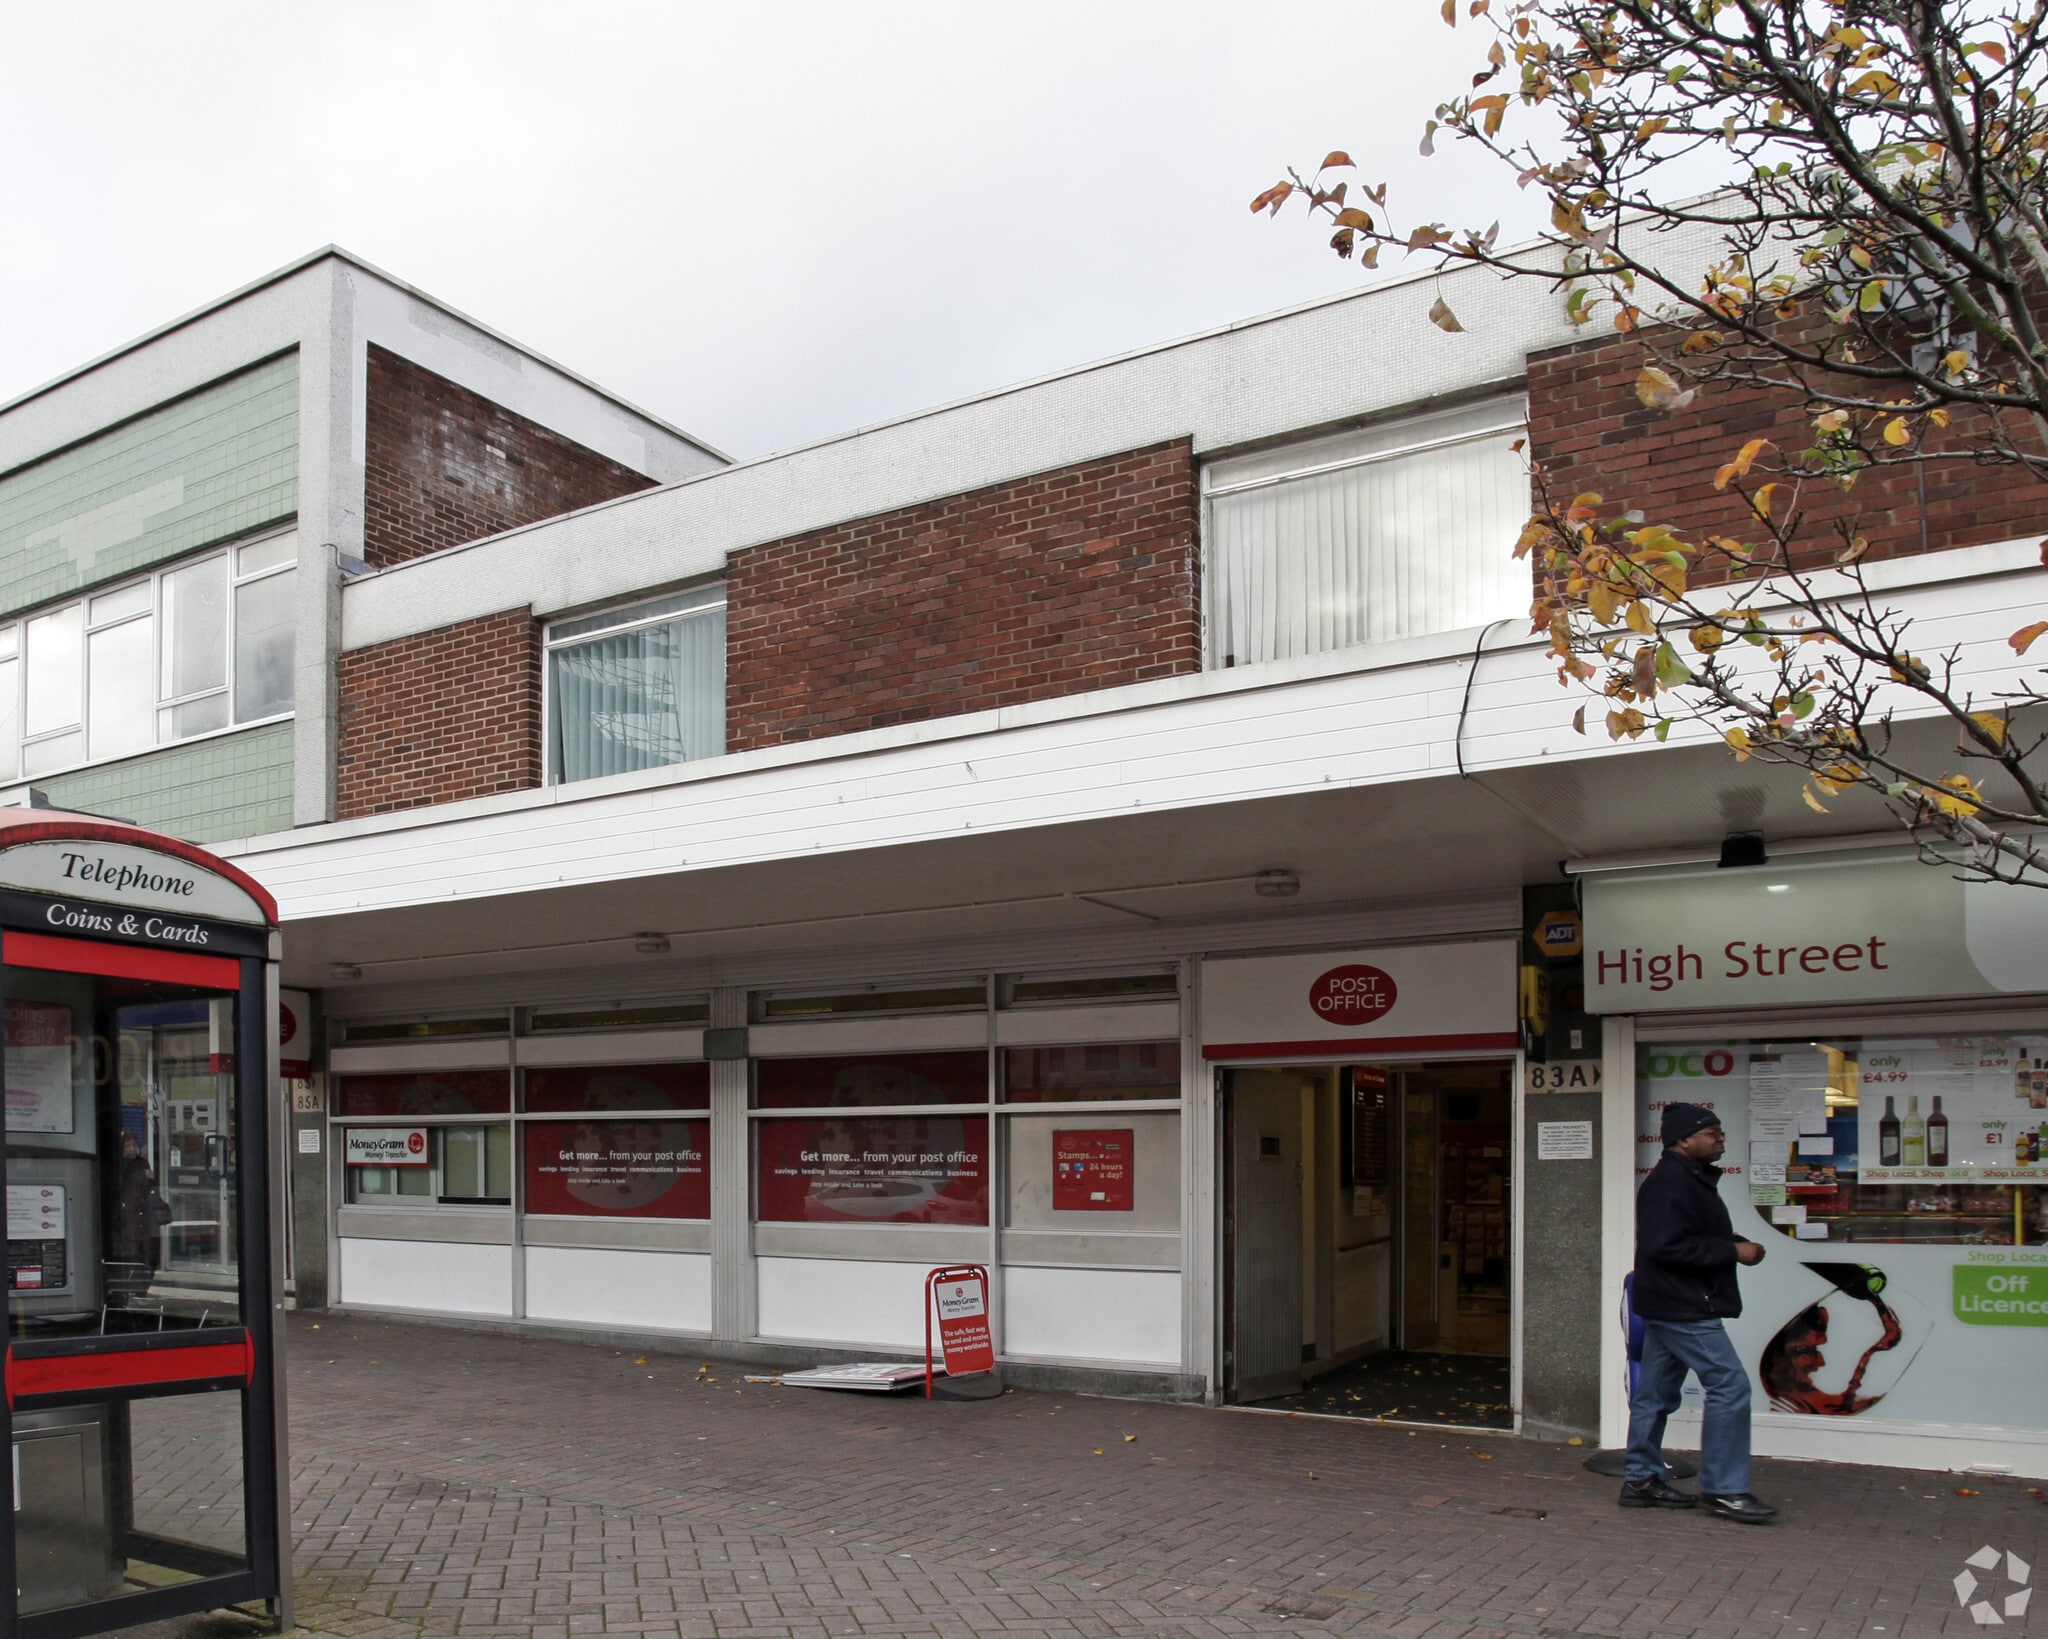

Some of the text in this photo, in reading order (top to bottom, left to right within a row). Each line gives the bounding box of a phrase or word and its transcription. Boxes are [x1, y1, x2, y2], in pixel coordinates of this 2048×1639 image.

[61, 853, 195, 896] Telephone
[46, 904, 209, 944] Coins & Cards
[1546, 926, 1576, 941] ADT
[1597, 936, 1888, 991] High Street
[1329, 976, 1379, 993] POST
[1317, 993, 1386, 1011] OFFICE
[1981, 1046, 2006, 1057] only
[1869, 1055, 1901, 1068] only
[1979, 1058, 2009, 1067] £3.99
[1531, 1065, 1588, 1089] 83A
[1862, 1071, 1908, 1083] £4.99
[297, 1096, 320, 1110] 85A
[1982, 1120, 2007, 1130] only
[349, 1138, 405, 1152] MoneyGram
[1985, 1133, 2003, 1144] £1
[364, 1150, 408, 1160] Money Transfer
[559, 1150, 702, 1162] Get more... from your post office
[800, 1150, 979, 1165] Get more... from your post office
[538, 1165, 558, 1173] savings
[560, 1165, 579, 1173] lending
[774, 1167, 978, 1177] savings lending insurance travel communications business
[1866, 1170, 1890, 1178] Shop
[1921, 1170, 1945, 1178] Shop
[1983, 1169, 2009, 1178] Shop
[1968, 1250, 2006, 1263] Shop
[1986, 1274, 2029, 1293] Off
[942, 1297, 979, 1307] MoneyGram
[1960, 1294, 2048, 1314] Licence
[976, 1326, 986, 1334] way
